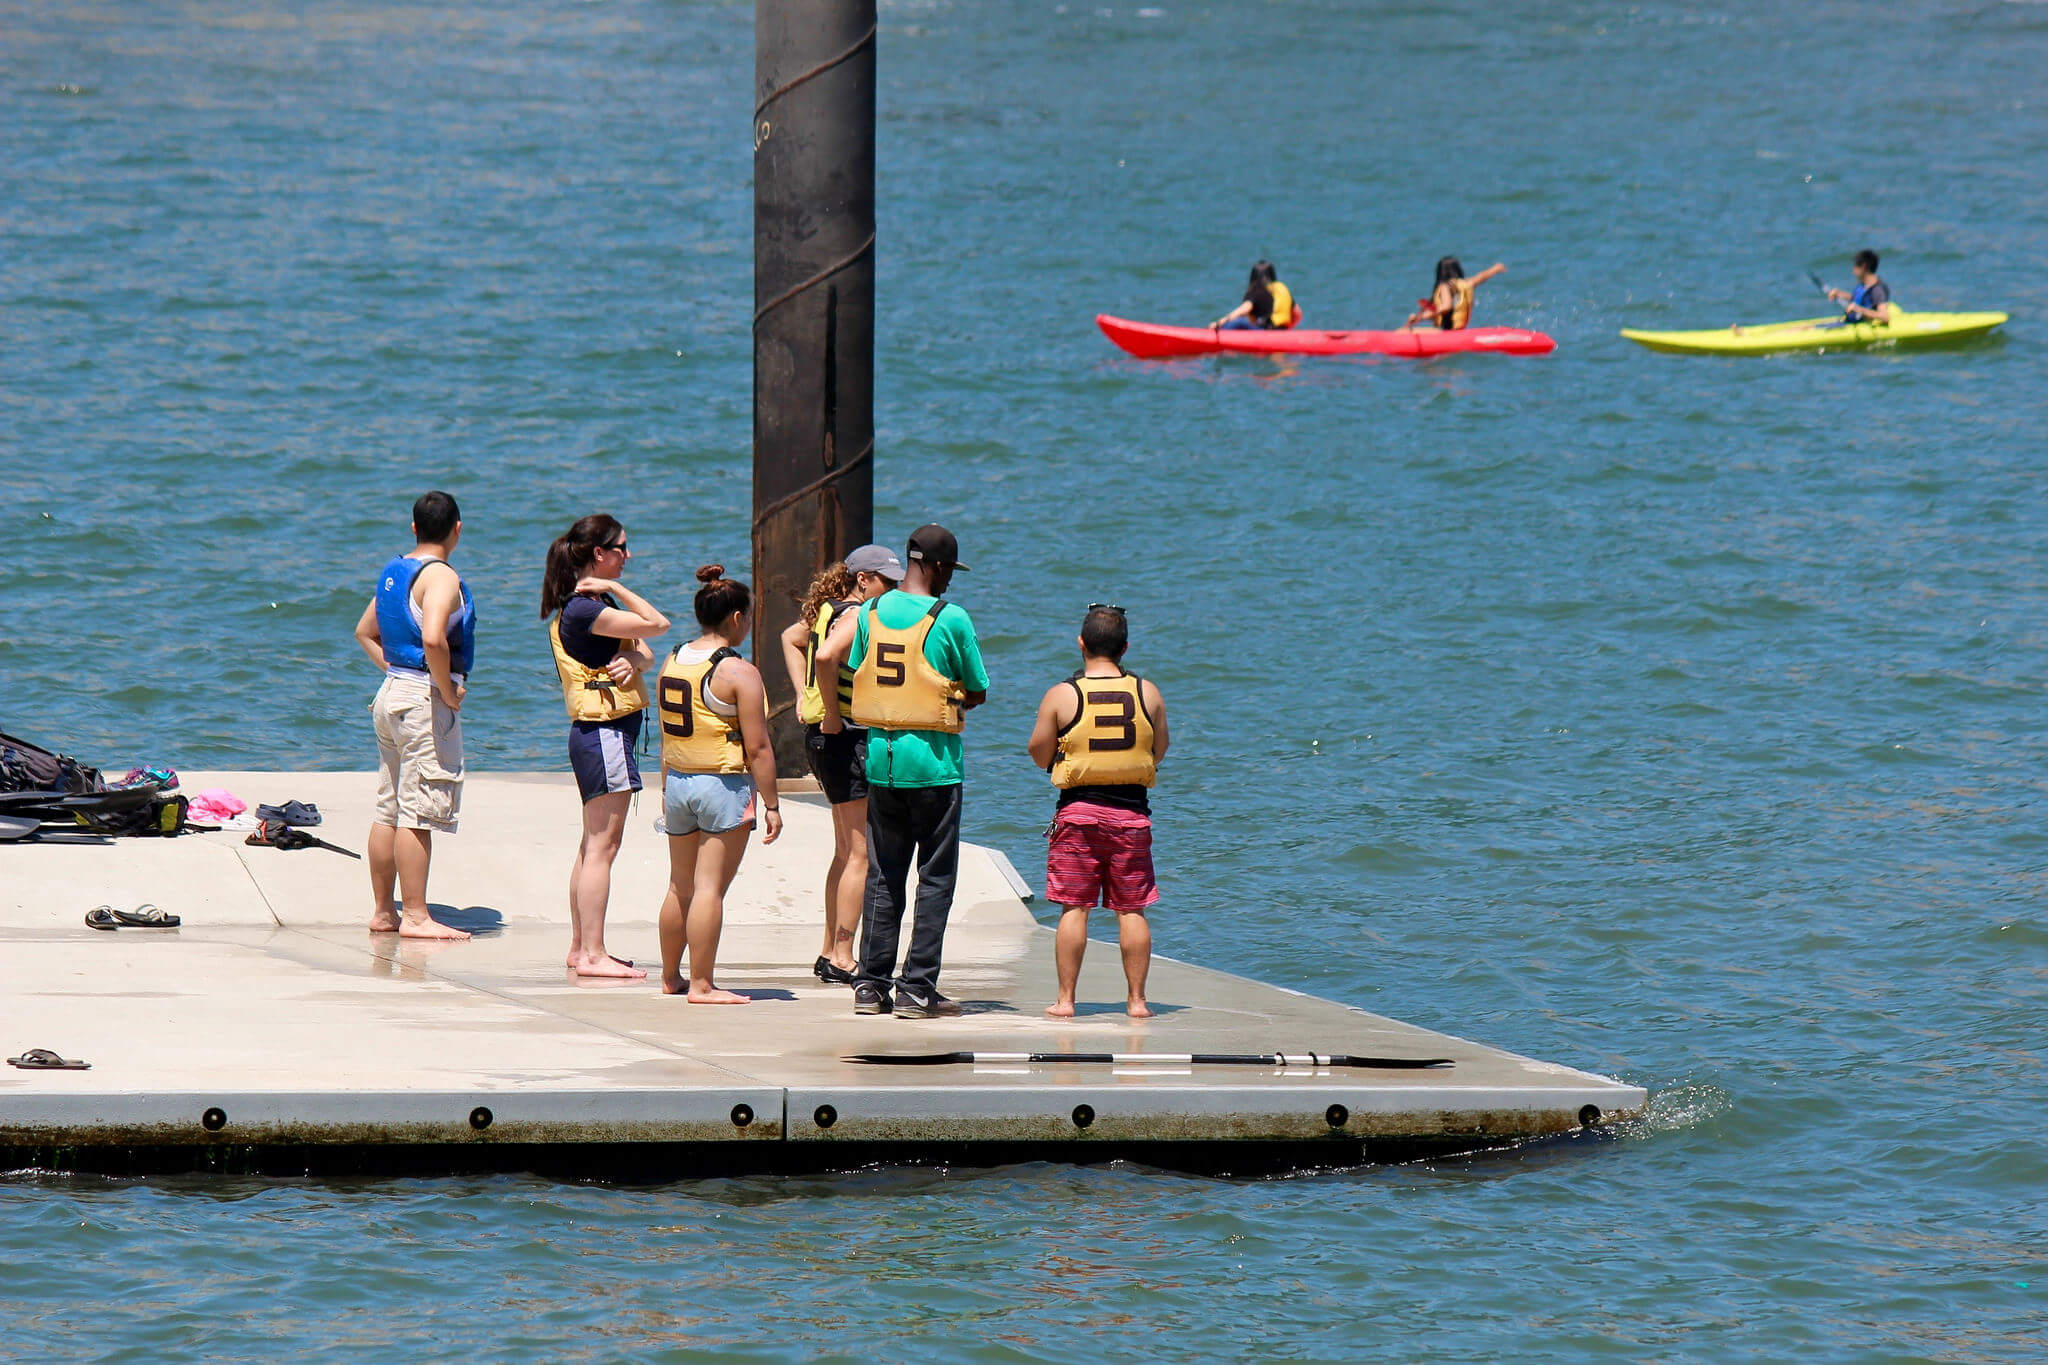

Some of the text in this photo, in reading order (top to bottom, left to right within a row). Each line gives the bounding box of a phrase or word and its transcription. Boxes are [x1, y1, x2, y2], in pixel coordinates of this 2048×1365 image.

[877, 643, 905, 686] 5
[659, 676, 694, 737] 9
[1087, 691, 1137, 752] 3
